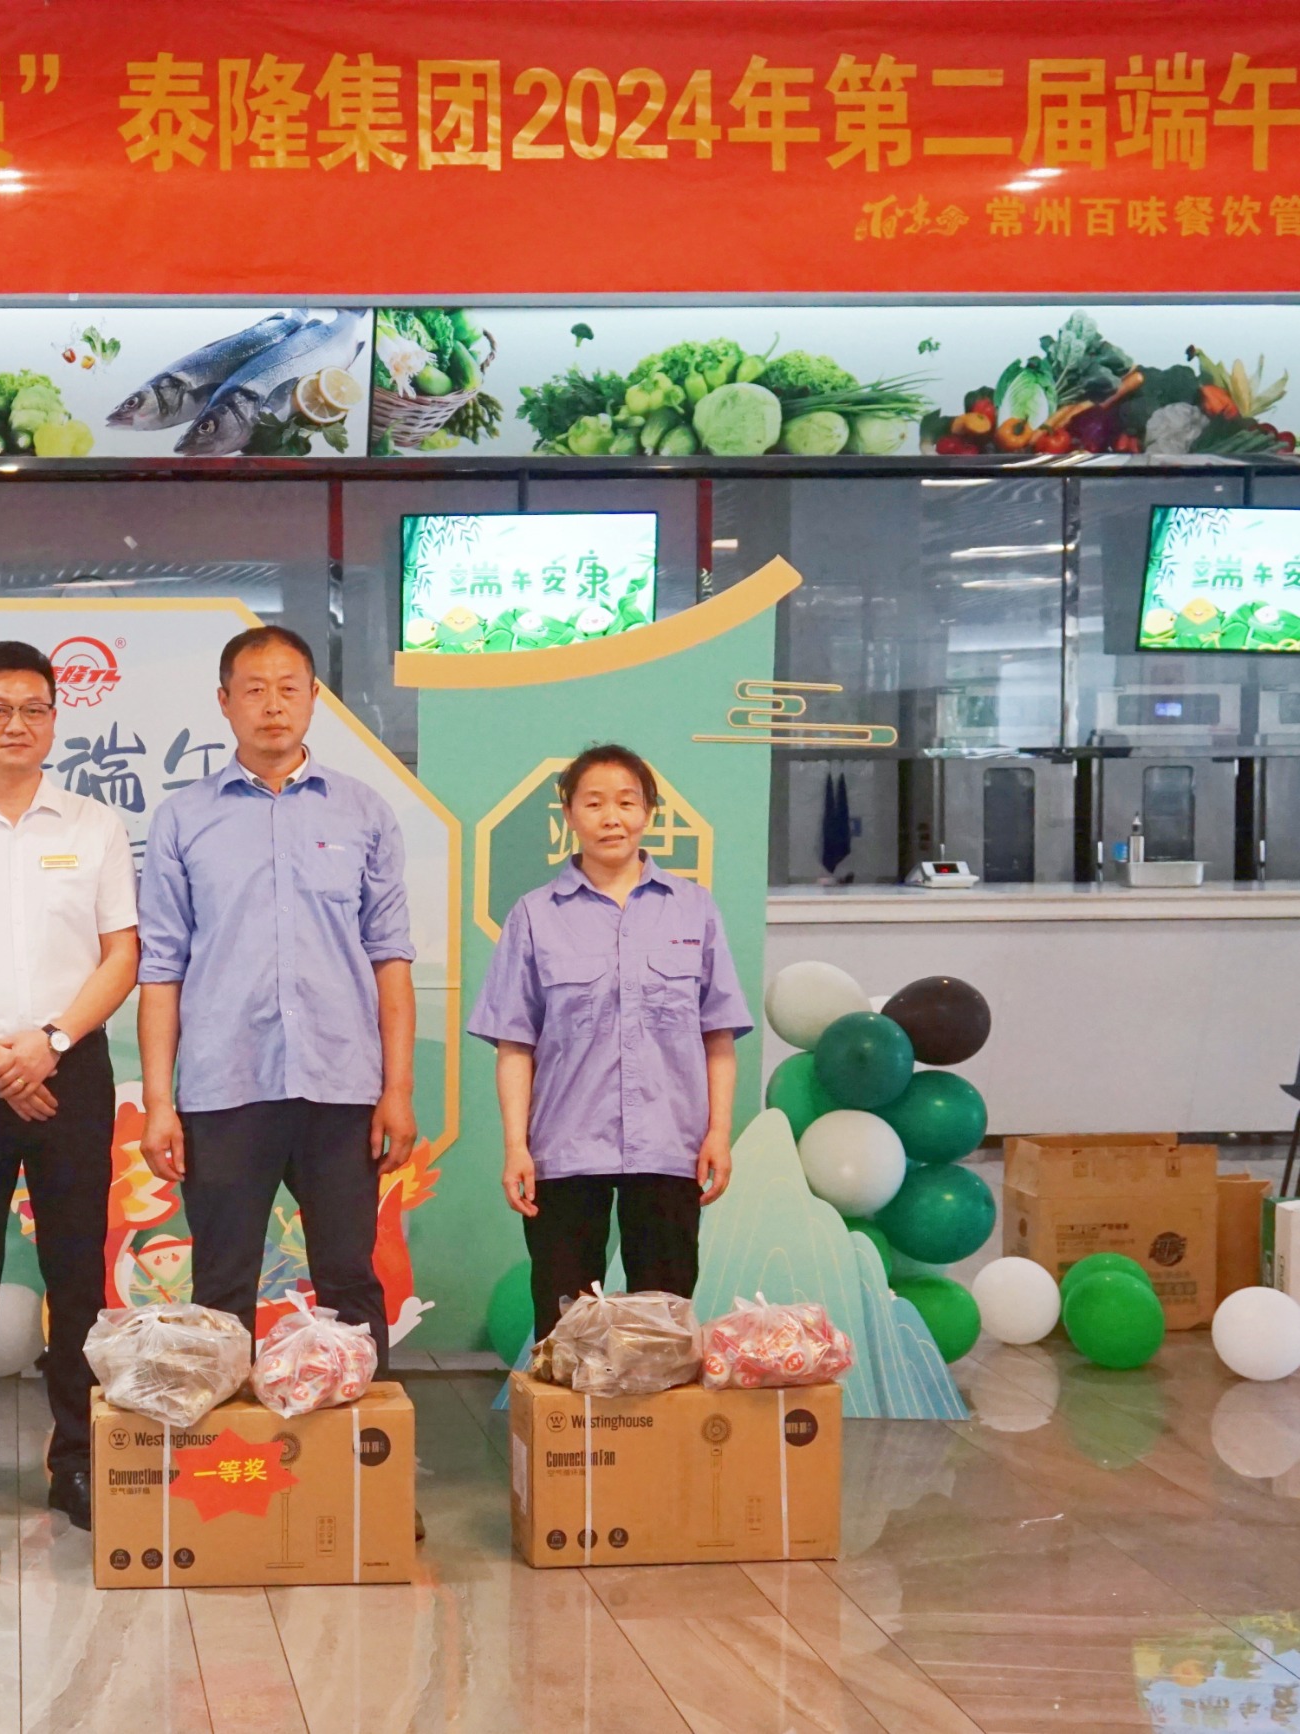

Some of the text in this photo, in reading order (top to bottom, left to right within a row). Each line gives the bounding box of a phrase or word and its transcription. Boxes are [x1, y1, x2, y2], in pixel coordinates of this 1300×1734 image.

[985, 194, 1300, 237] 常州百味餐饮管
[449, 549, 611, 600] 端午安康
[193, 1458, 268, 1484] 一等奖
